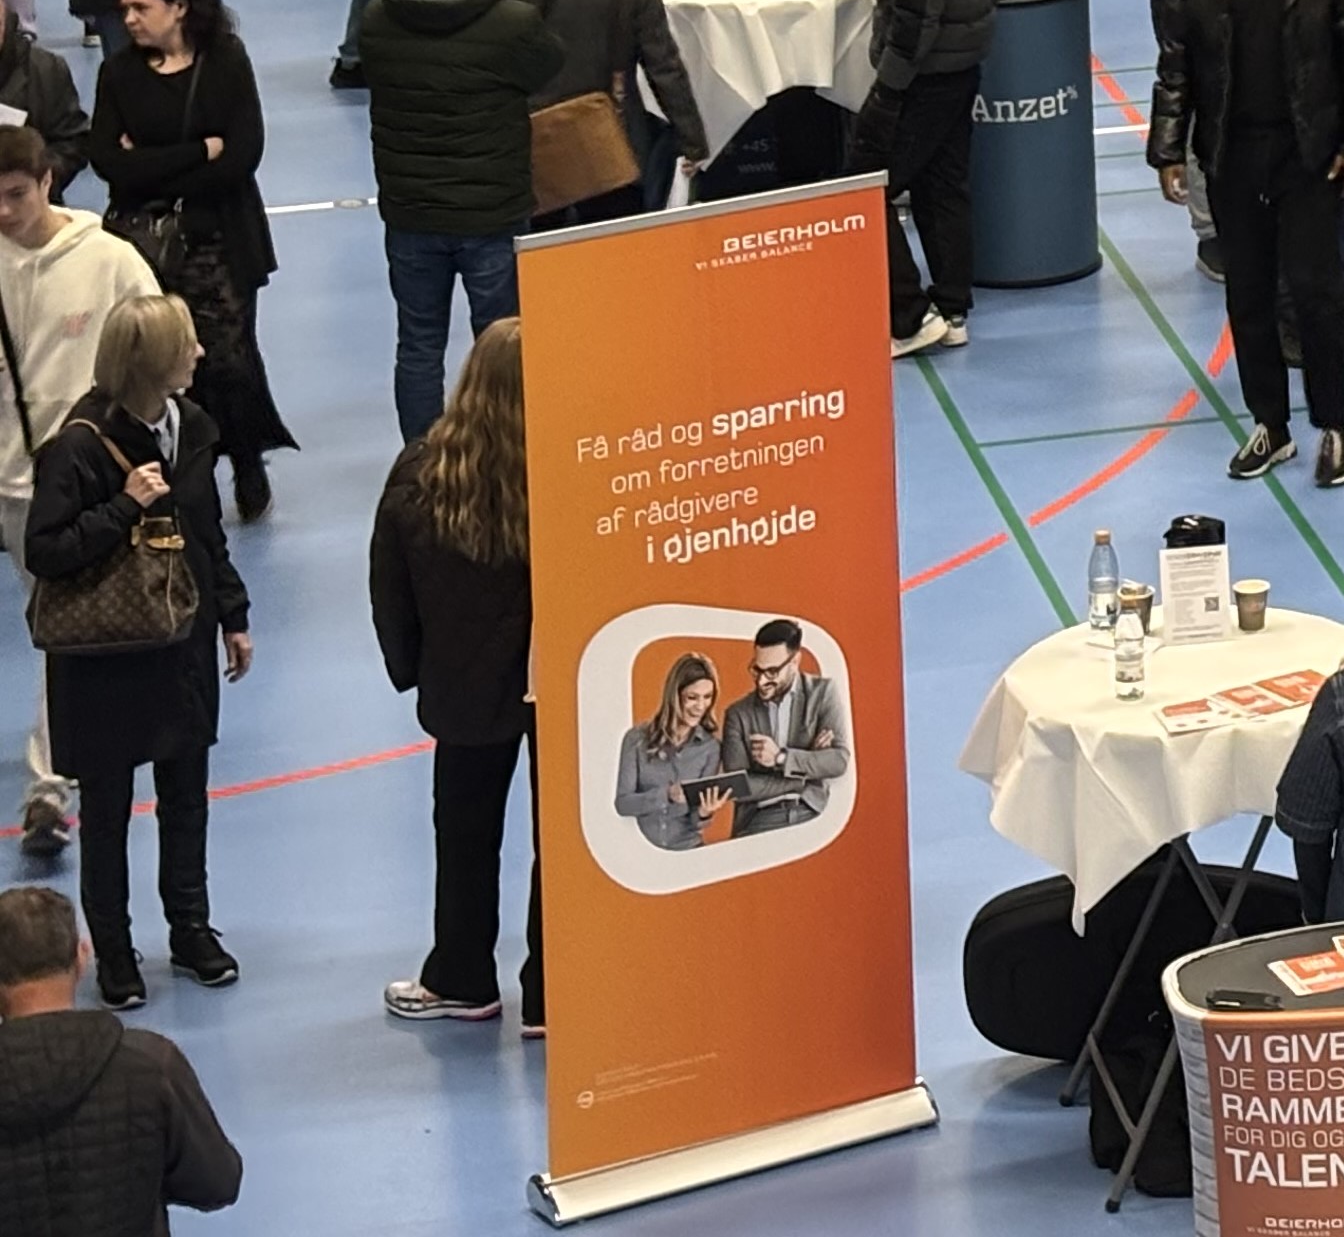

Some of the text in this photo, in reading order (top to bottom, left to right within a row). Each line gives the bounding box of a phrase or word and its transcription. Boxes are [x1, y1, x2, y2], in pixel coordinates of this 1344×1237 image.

[971, 87, 1068, 123] Anzet
[723, 213, 866, 254] BEIERHOLM
[576, 389, 846, 464] Få råd og sparring
[610, 434, 825, 495] om forretningen
[596, 484, 759, 536] af rådgivere
[646, 504, 817, 565] i øjenhøjde
[1214, 1030, 1252, 1063] VI
[1218, 1066, 1256, 1090] DE
[1224, 1125, 1265, 1147] FOR
[1270, 1127, 1307, 1148] DIG
[1312, 1126, 1344, 1147] OG
